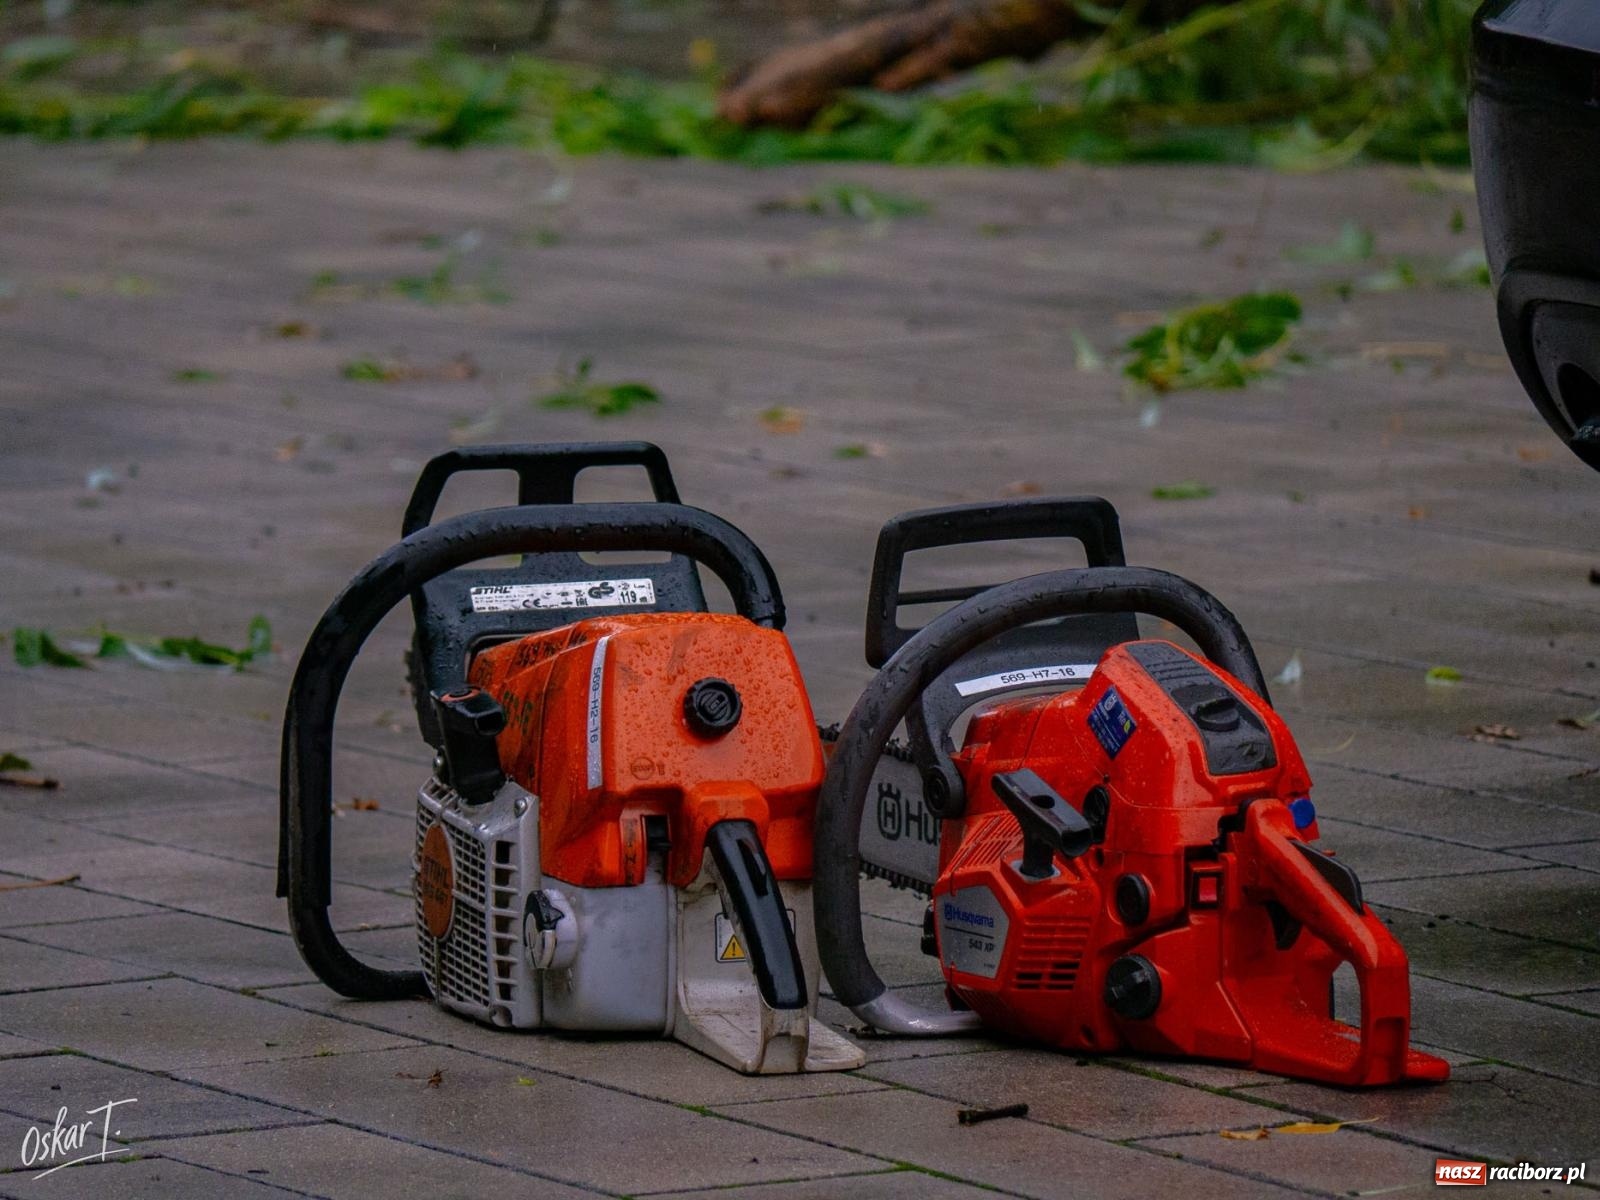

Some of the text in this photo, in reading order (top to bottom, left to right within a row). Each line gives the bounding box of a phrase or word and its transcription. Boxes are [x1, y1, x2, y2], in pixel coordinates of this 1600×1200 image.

[472, 586, 513, 595] STIHL
[620, 591, 637, 604] 119
[1000, 667, 1076, 684] 569-H7-16
[589, 666, 602, 744] 569-H2-16
[951, 905, 995, 929] Husqvarna
